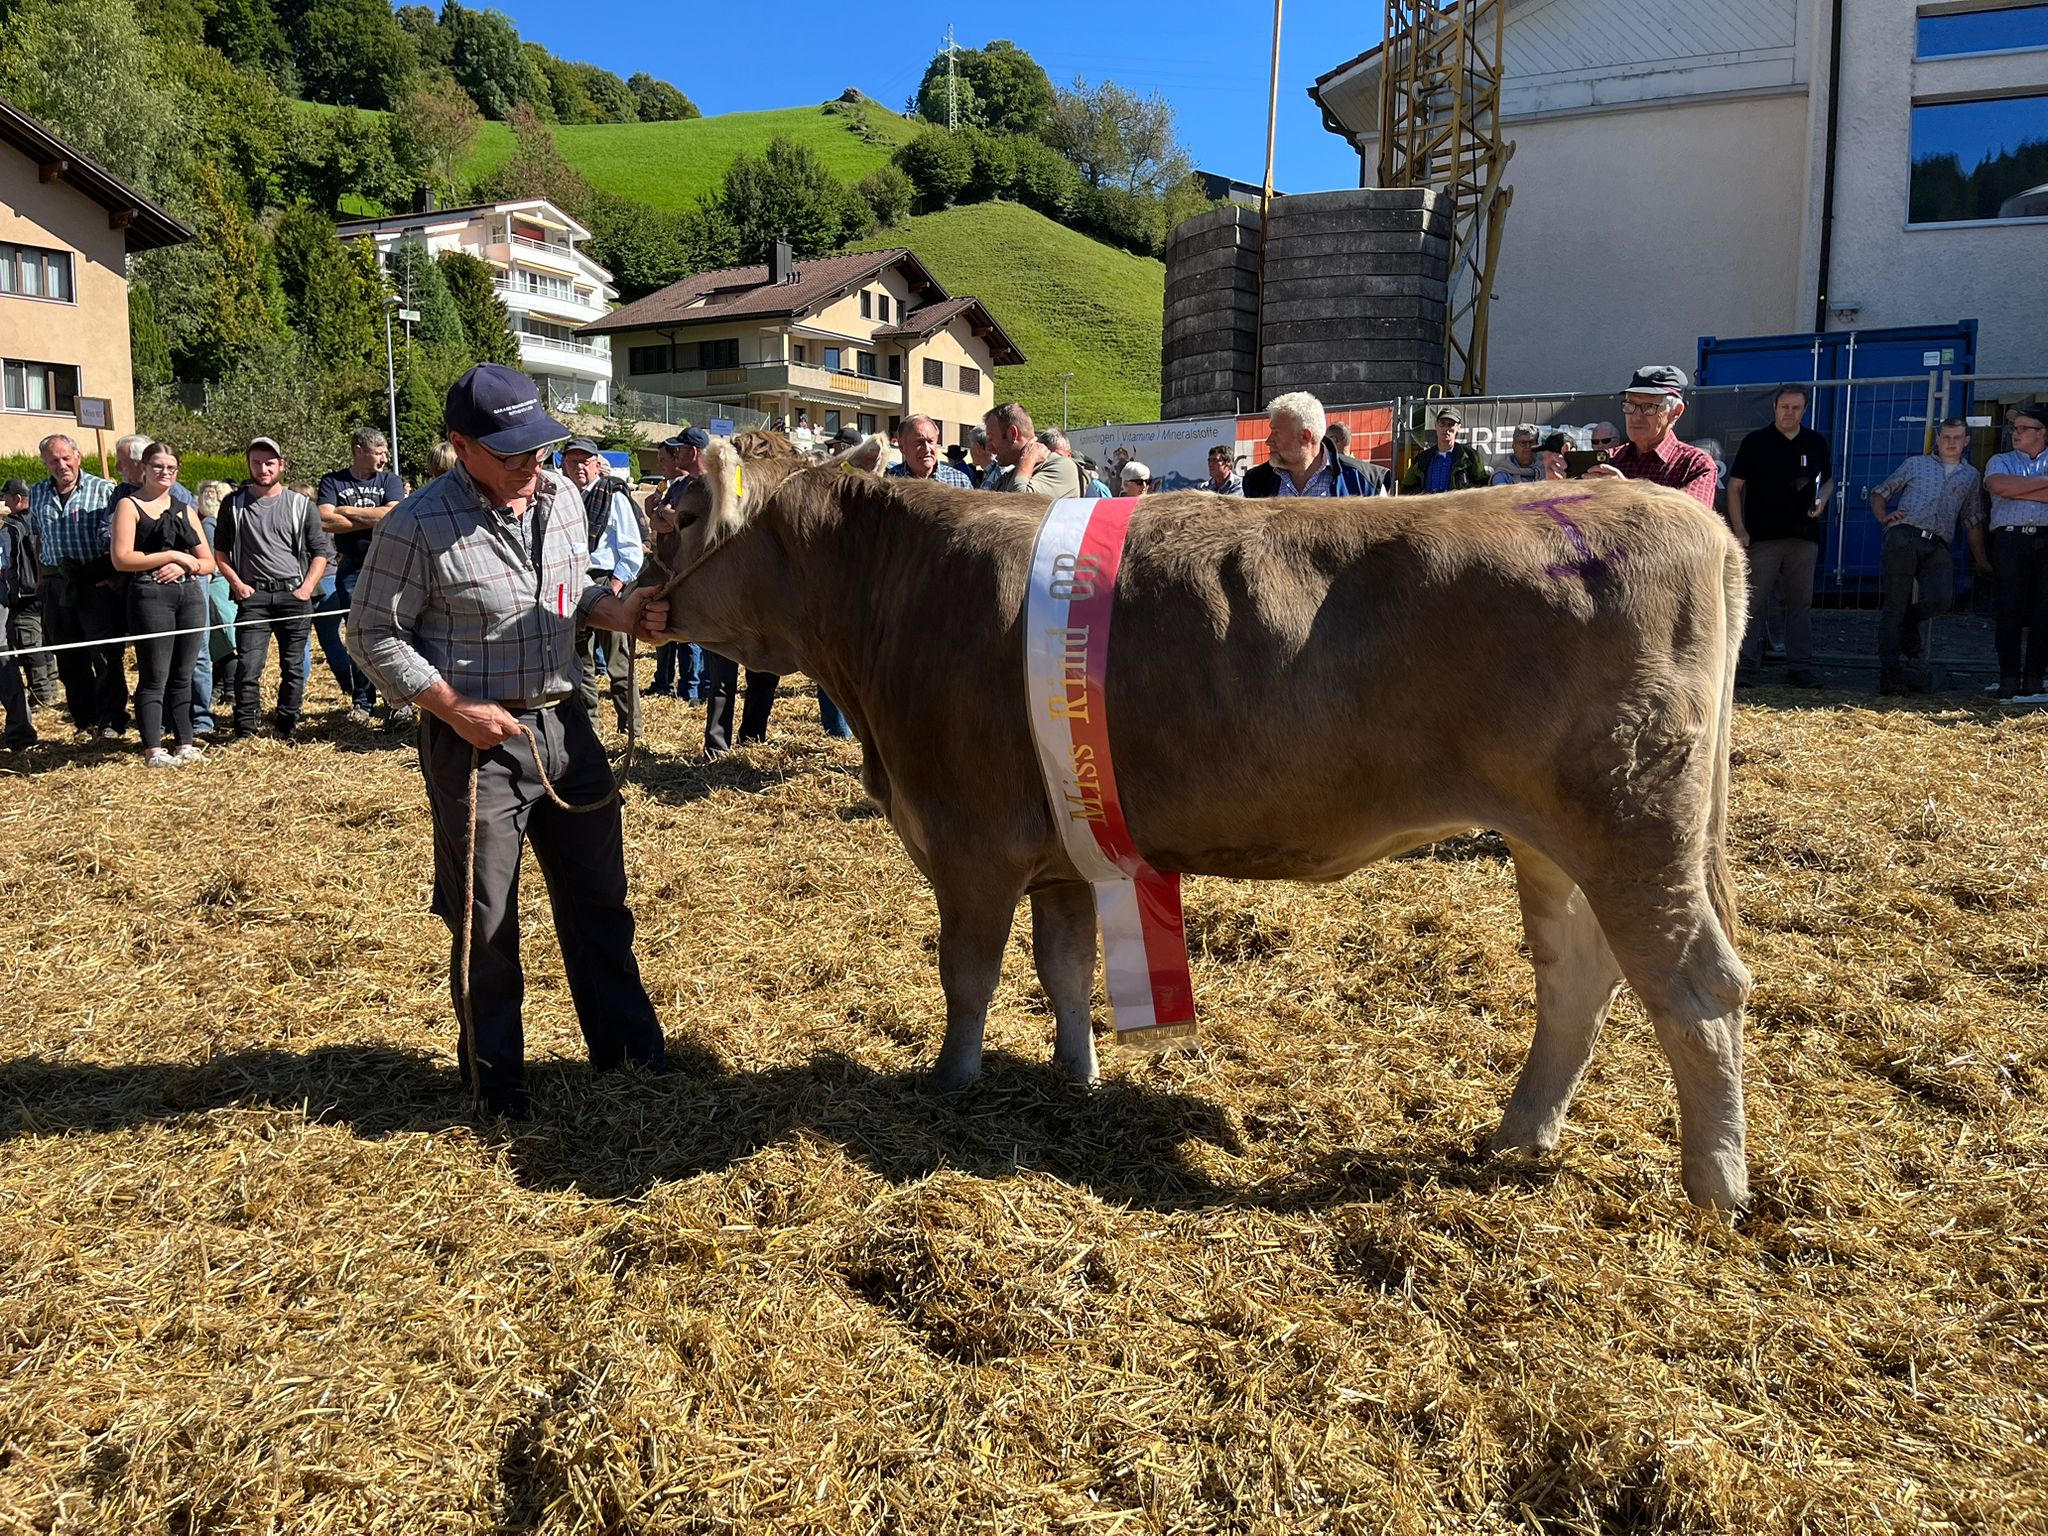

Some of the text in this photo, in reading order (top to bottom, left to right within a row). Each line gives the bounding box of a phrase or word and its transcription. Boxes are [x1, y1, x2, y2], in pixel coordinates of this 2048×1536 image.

[1121, 431, 1155, 442] Vitamine
[1161, 427, 1219, 441] Mineralstoffe
[1046, 624, 1090, 724] Rind
[1062, 744, 1109, 828] Miss
